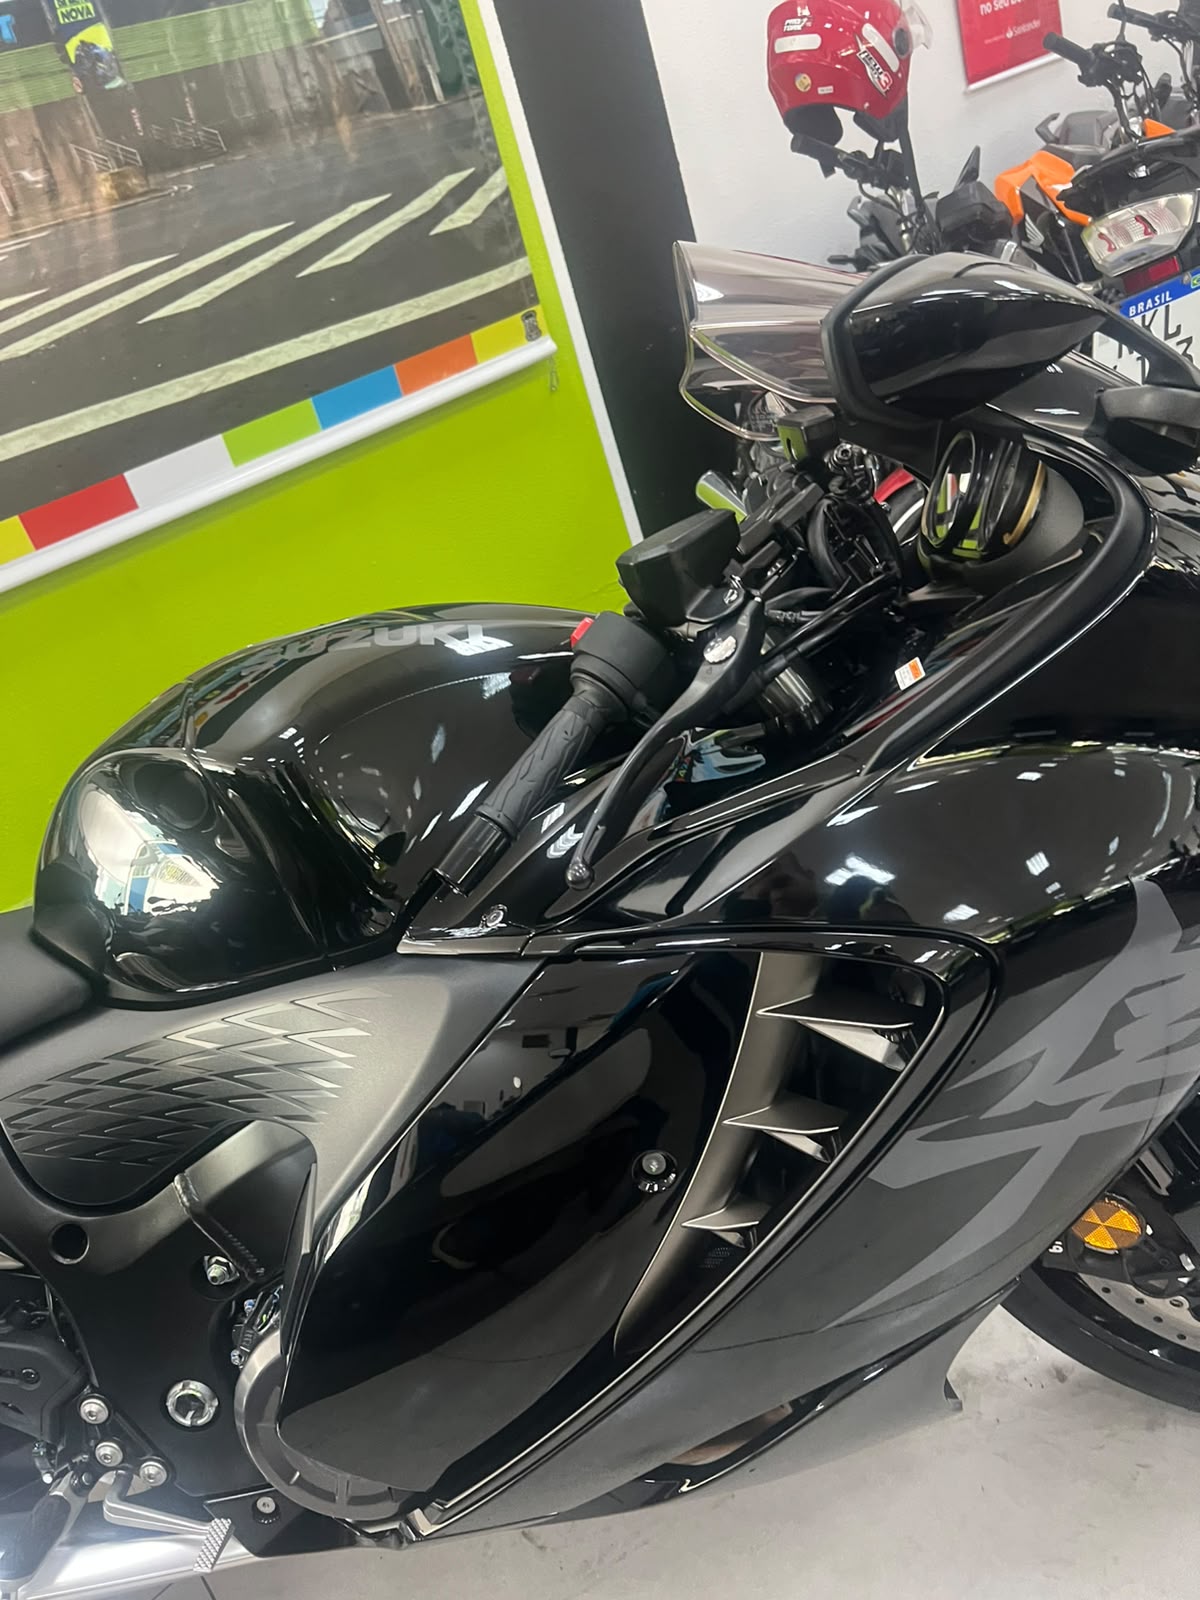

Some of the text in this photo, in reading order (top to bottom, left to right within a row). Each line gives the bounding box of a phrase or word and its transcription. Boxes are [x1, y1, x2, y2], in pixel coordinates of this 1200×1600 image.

[60, 5, 94, 23] NOVA
[979, 2, 993, 16] no
[1012, 19, 1041, 36] Santander
[1128, 291, 1173, 317] BRASIL
